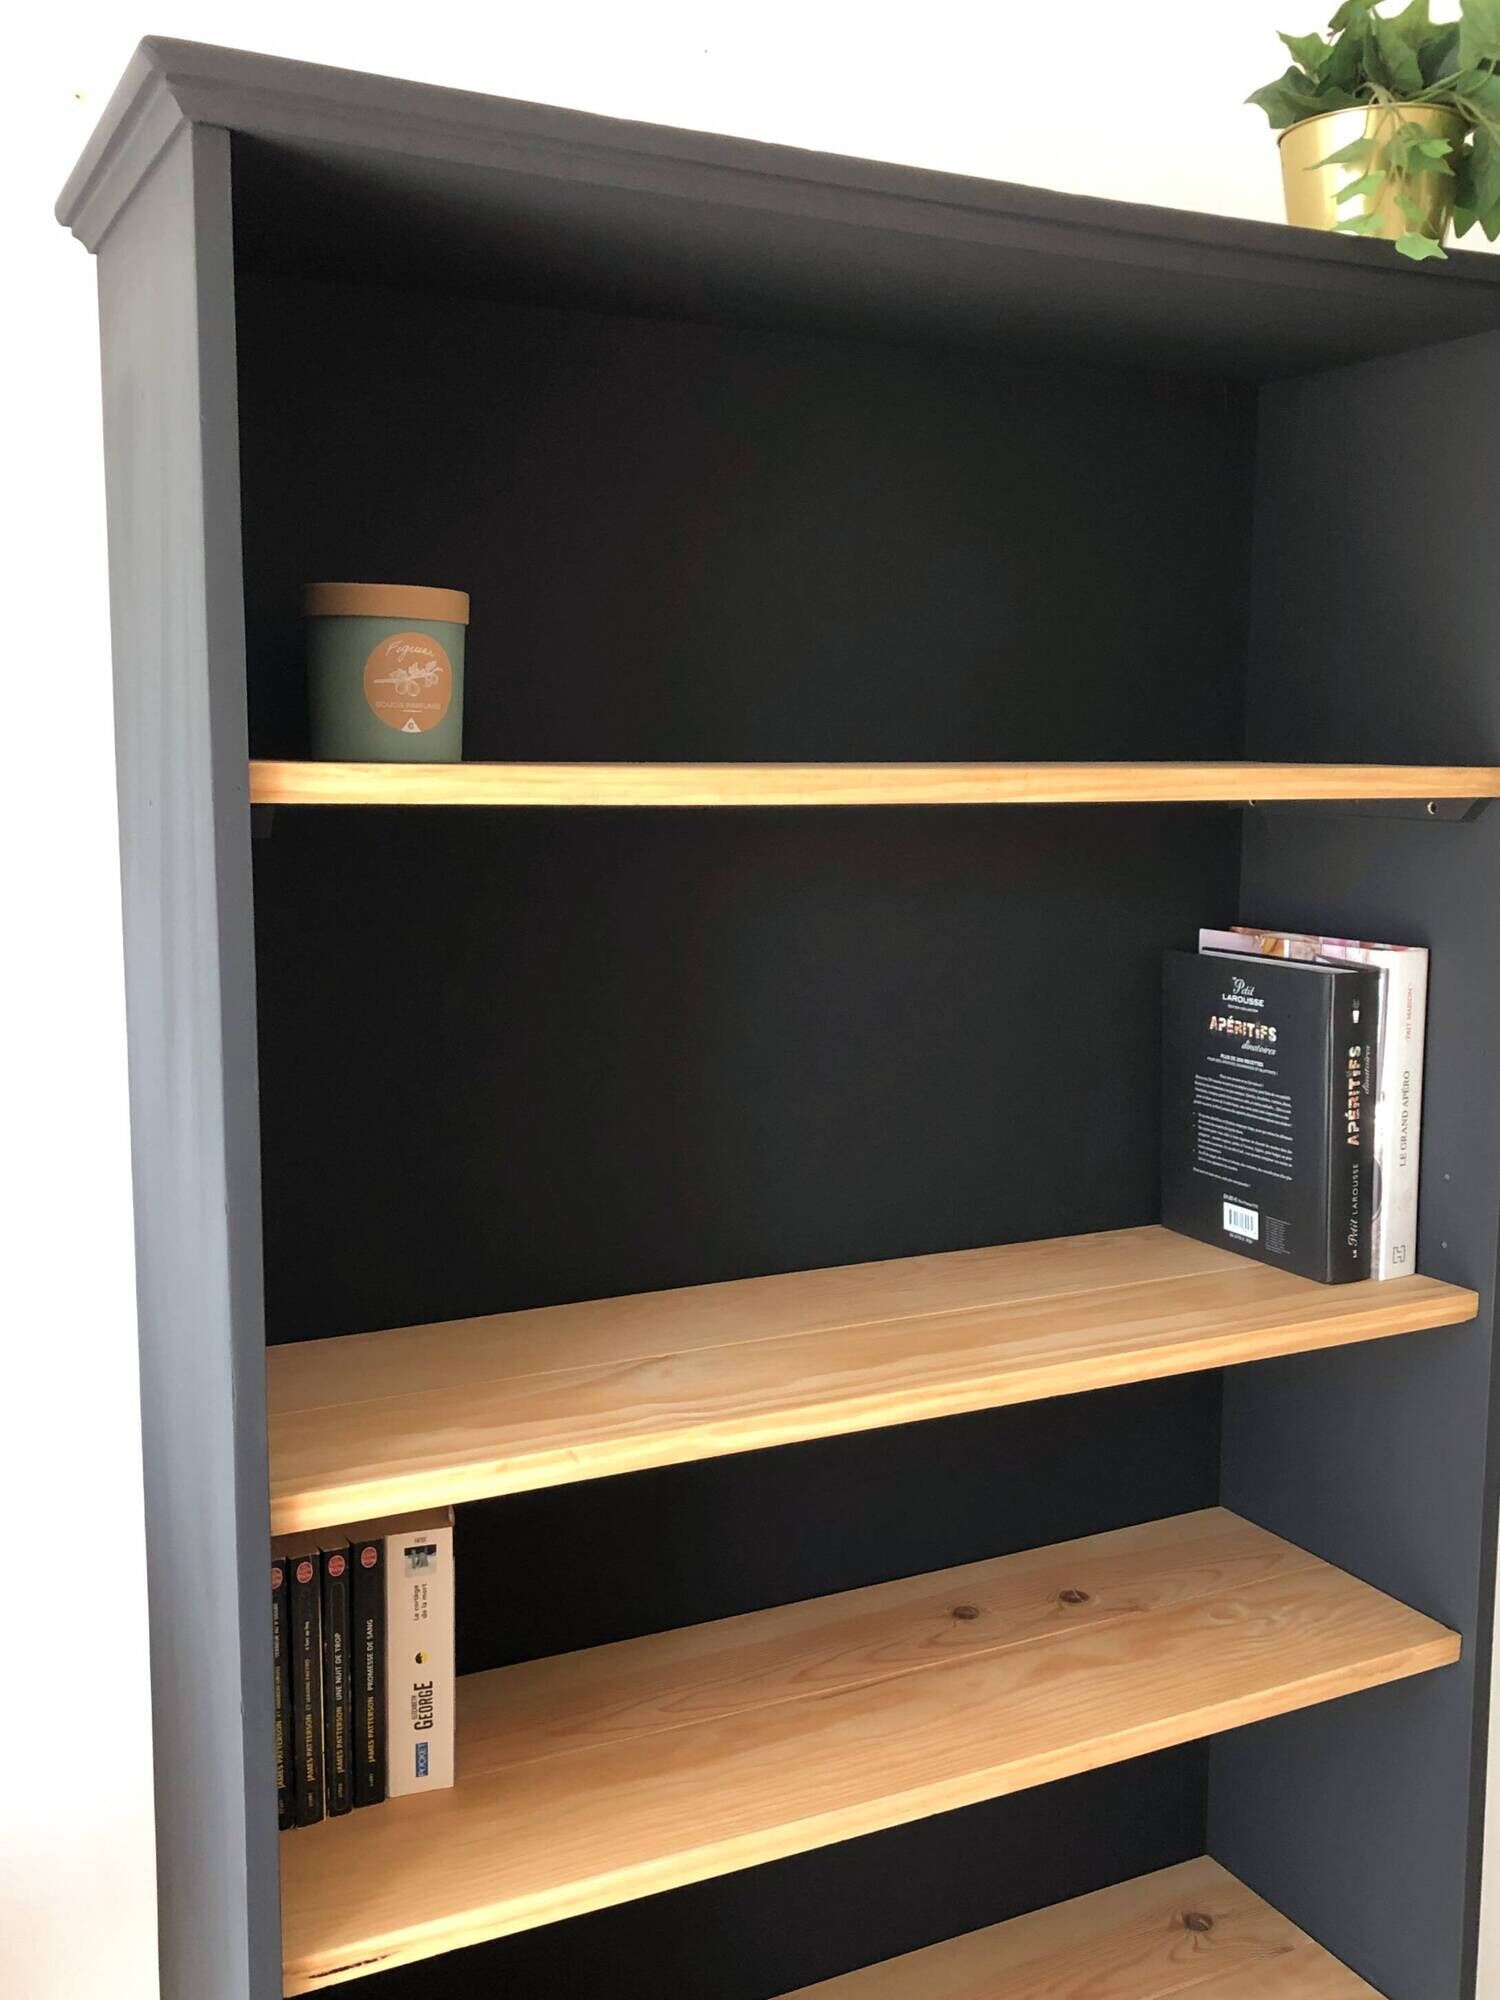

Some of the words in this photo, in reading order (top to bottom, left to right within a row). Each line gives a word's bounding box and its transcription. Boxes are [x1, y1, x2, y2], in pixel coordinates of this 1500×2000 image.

[1232, 977, 1255, 996] Petit
[1222, 993, 1265, 1007] LAROUSSE
[1209, 1015, 1277, 1042] APÉRITIFS
[1345, 1046, 1361, 1145] APÉRITIFS
[1401, 1070, 1410, 1107] APÉRO
[1400, 1110, 1409, 1151] GRAND
[1400, 1153, 1407, 1167] LE
[1347, 1218, 1359, 1246] Petit
[421, 1610, 427, 1619] de
[367, 1641, 373, 1651] DE
[336, 1655, 342, 1665] DE
[414, 1681, 433, 1731] GEORGE
[336, 1749, 345, 1774] JAMES
[368, 1740, 376, 1763] JAMES
[417, 1743, 427, 1777] POCKET
[306, 1758, 315, 1782] JAMES
